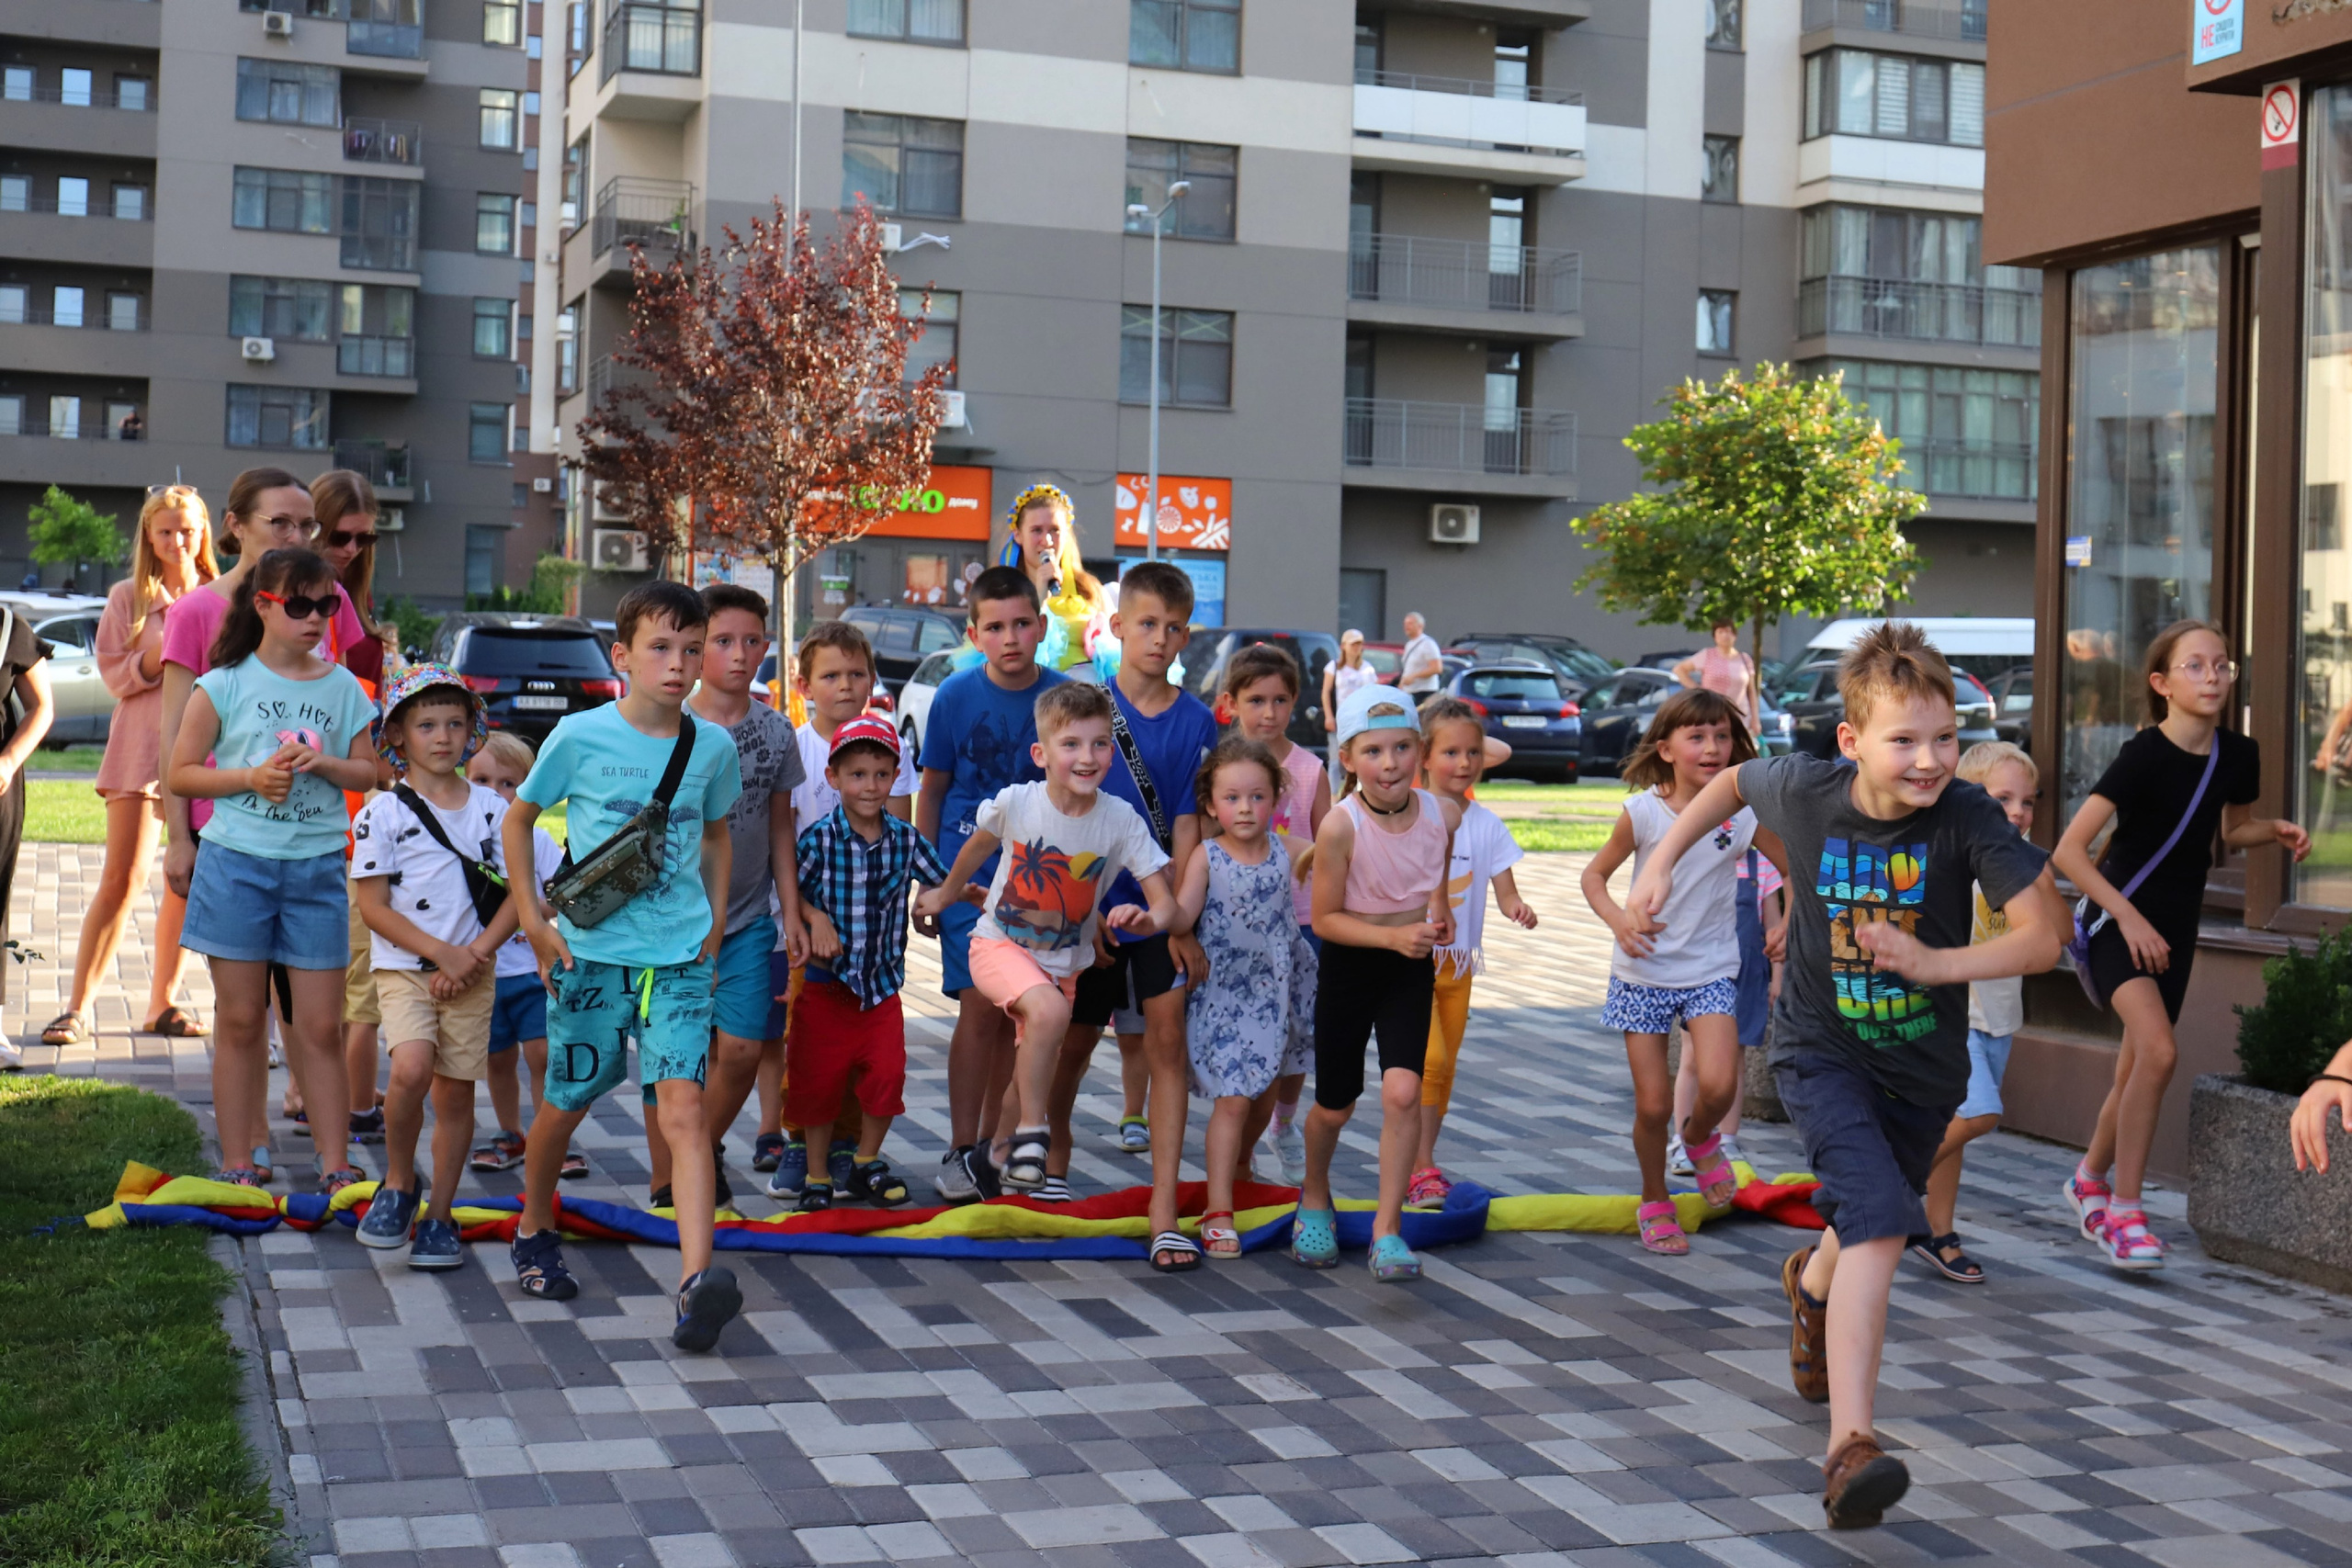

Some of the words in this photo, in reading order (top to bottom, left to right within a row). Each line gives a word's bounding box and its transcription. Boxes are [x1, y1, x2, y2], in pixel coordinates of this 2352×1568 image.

[601, 766, 616, 777] SEA
[619, 767, 650, 779] TURTLE
[813, 781, 826, 798] JUST
[1815, 836, 1928, 905] ADV
